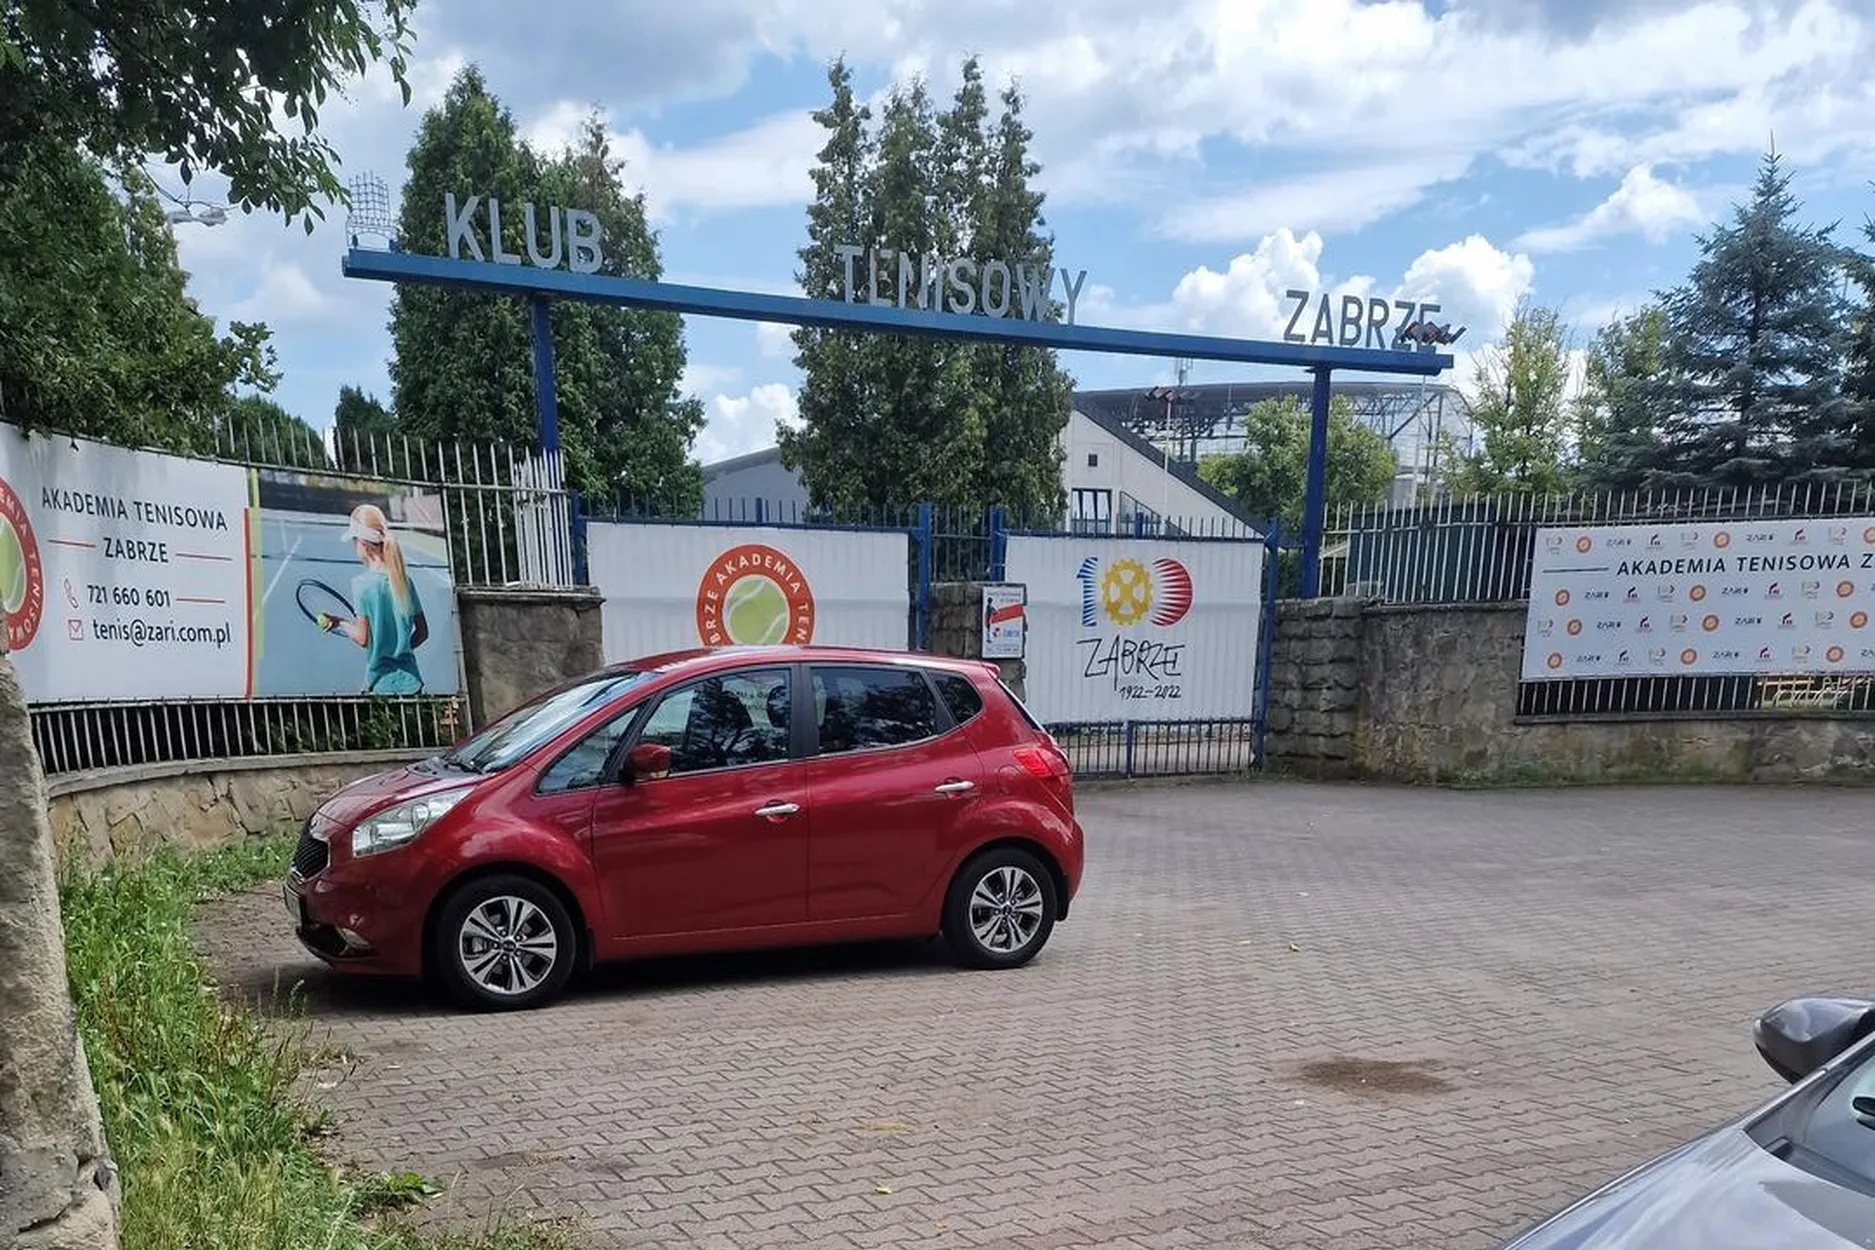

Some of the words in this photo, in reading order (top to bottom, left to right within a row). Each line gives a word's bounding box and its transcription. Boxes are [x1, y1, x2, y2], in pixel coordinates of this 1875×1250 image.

[444, 192, 604, 274] KLUB
[833, 244, 1088, 325] TENISOWY
[1284, 289, 1441, 354] ZABRZE
[42, 486, 129, 521] AKADEMIA
[133, 501, 228, 531] TENISOWA
[103, 537, 169, 563] ZABRZE
[1616, 558, 1726, 576] AKADEMIA
[1736, 553, 1850, 573] TENISOWA
[1860, 552, 1875, 569] Z
[715, 553, 801, 594] AKADEMIA
[87, 584, 108, 605] 721
[113, 586, 140, 606] 660
[146, 589, 171, 608] 601
[93, 618, 231, 648] tenis@zari.com.pl
[1076, 634, 1185, 691] ZABRZE
